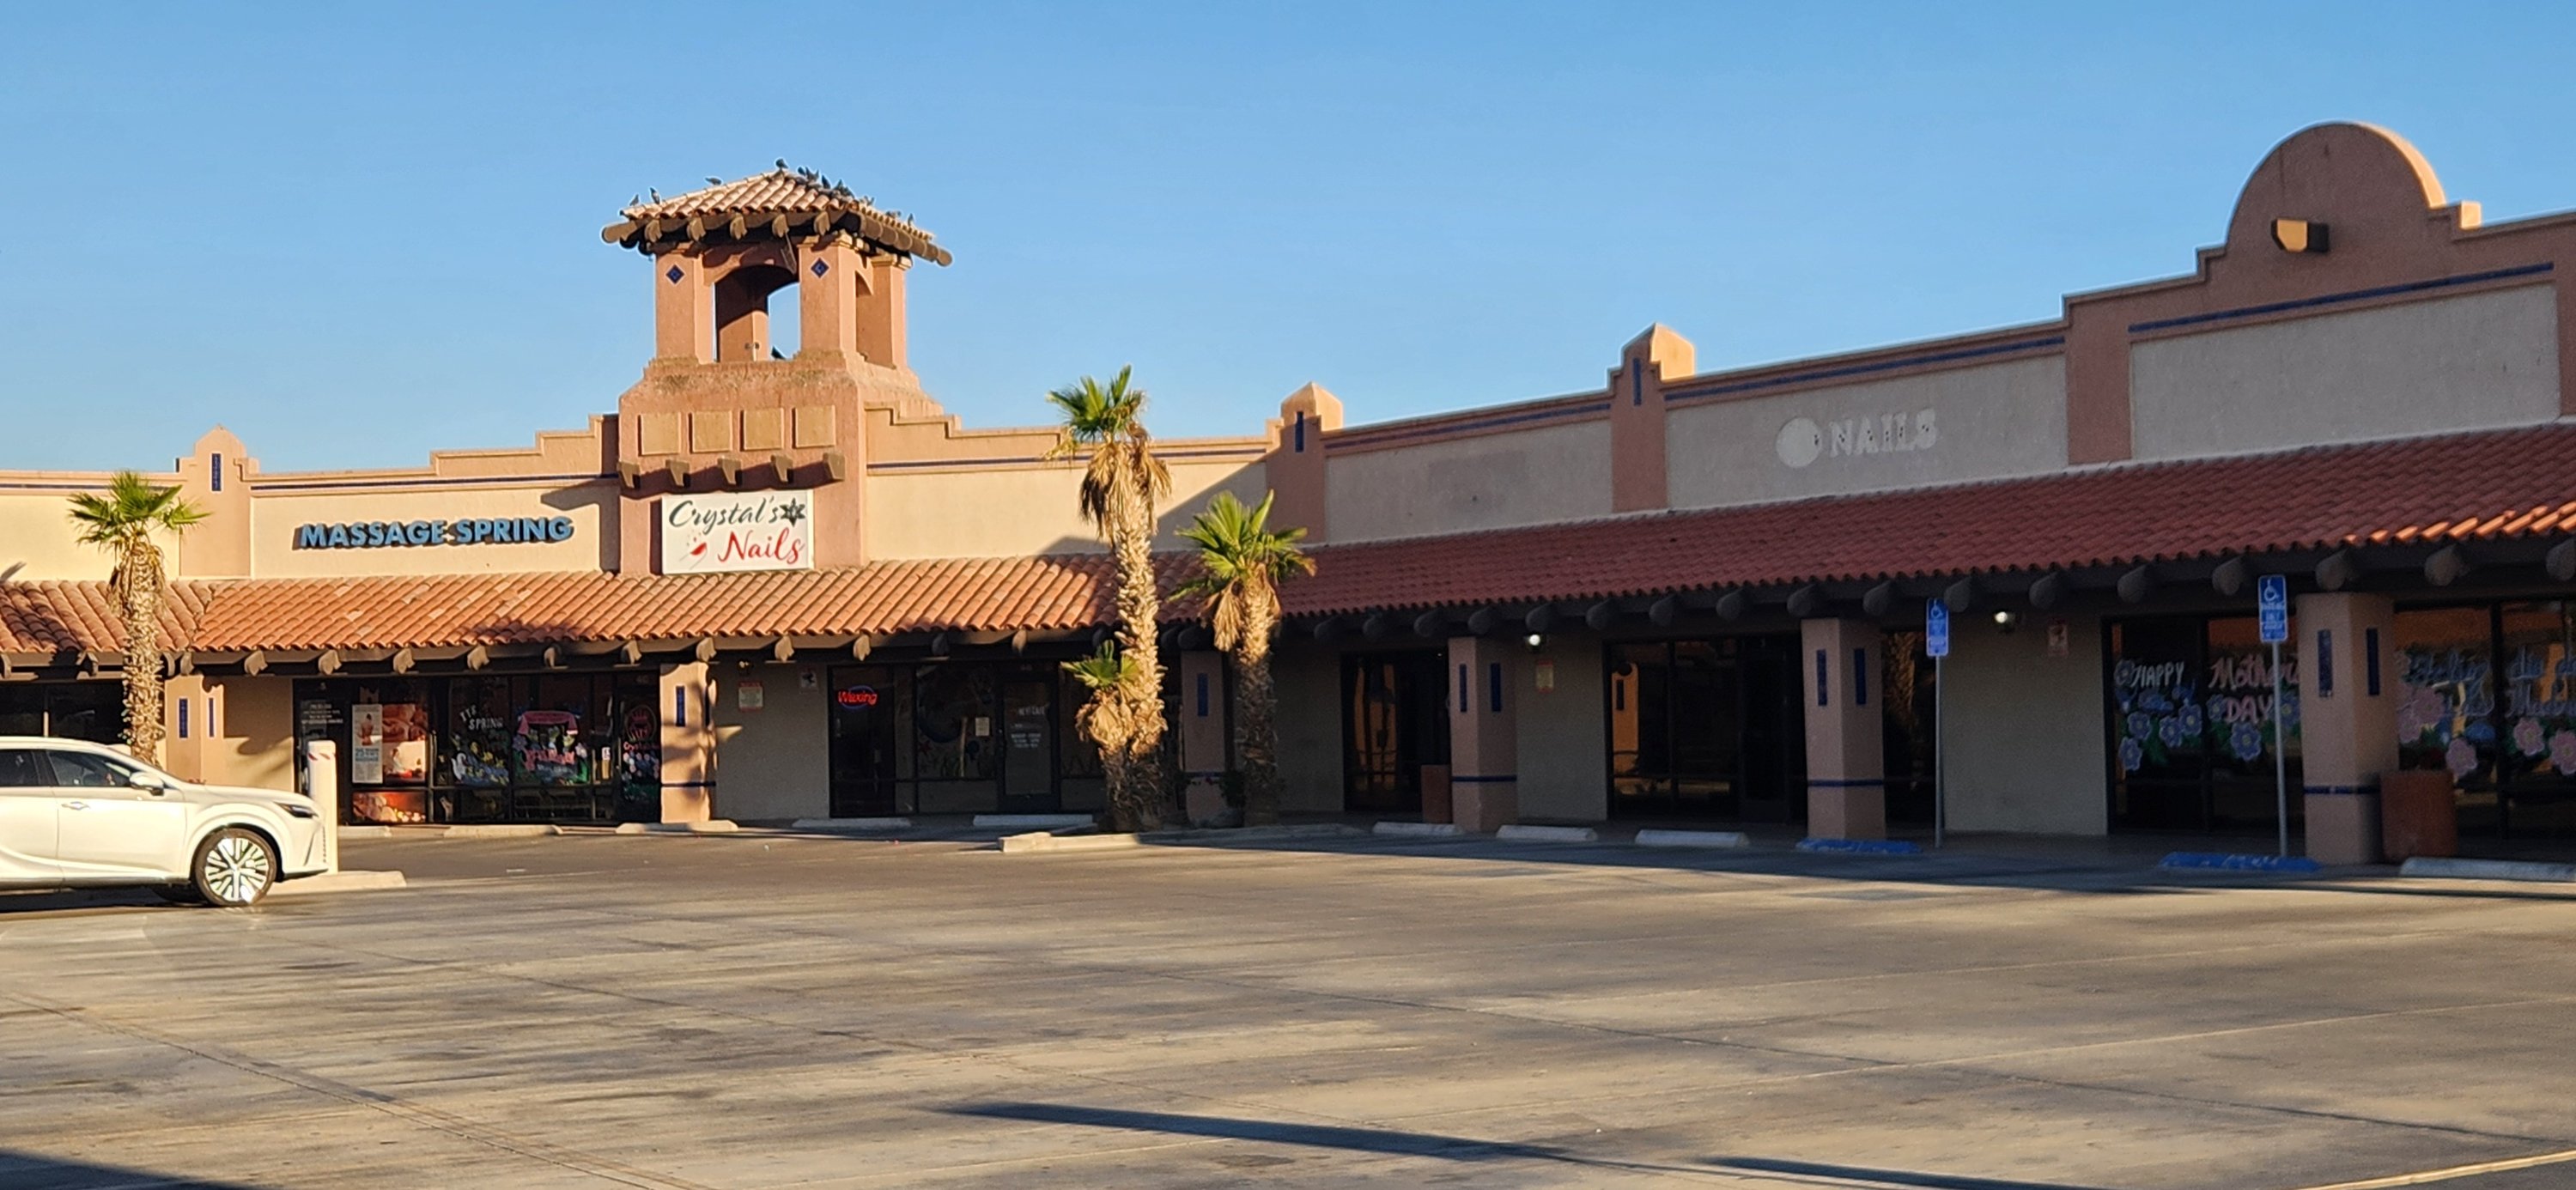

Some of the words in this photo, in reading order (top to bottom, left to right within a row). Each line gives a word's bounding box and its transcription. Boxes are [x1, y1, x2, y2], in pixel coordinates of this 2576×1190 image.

[1829, 409, 1936, 458] NAILS
[669, 496, 780, 536] Crystal's
[297, 520, 447, 549] MASSAGE
[453, 516, 574, 546] SPRING
[718, 527, 805, 565] Nails
[2129, 660, 2184, 688] HAPPY
[837, 689, 878, 707] Waxing
[2224, 694, 2274, 725] DAY
[468, 717, 504, 731] SPRING
